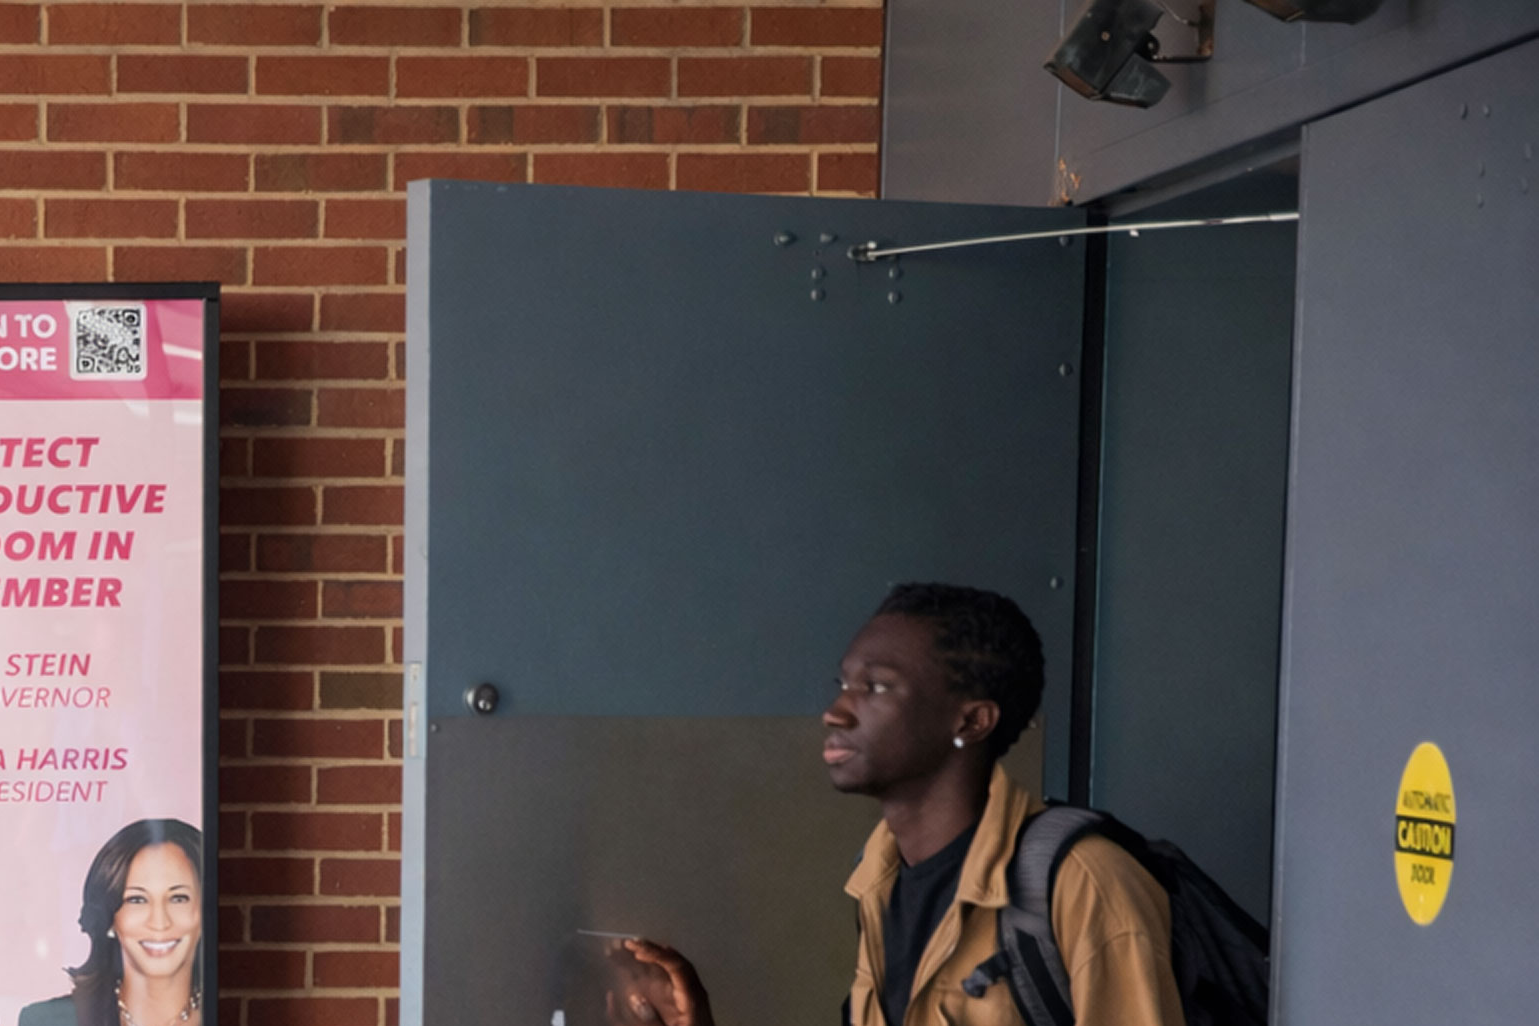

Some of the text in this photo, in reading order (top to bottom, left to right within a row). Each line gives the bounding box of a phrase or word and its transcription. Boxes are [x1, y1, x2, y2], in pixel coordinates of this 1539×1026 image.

[15, 314, 57, 339] TO
[87, 530, 134, 560] IN
[5, 653, 92, 677] STEIN
[16, 747, 129, 771] HARRIS
[1399, 821, 1451, 854] CAUTION
